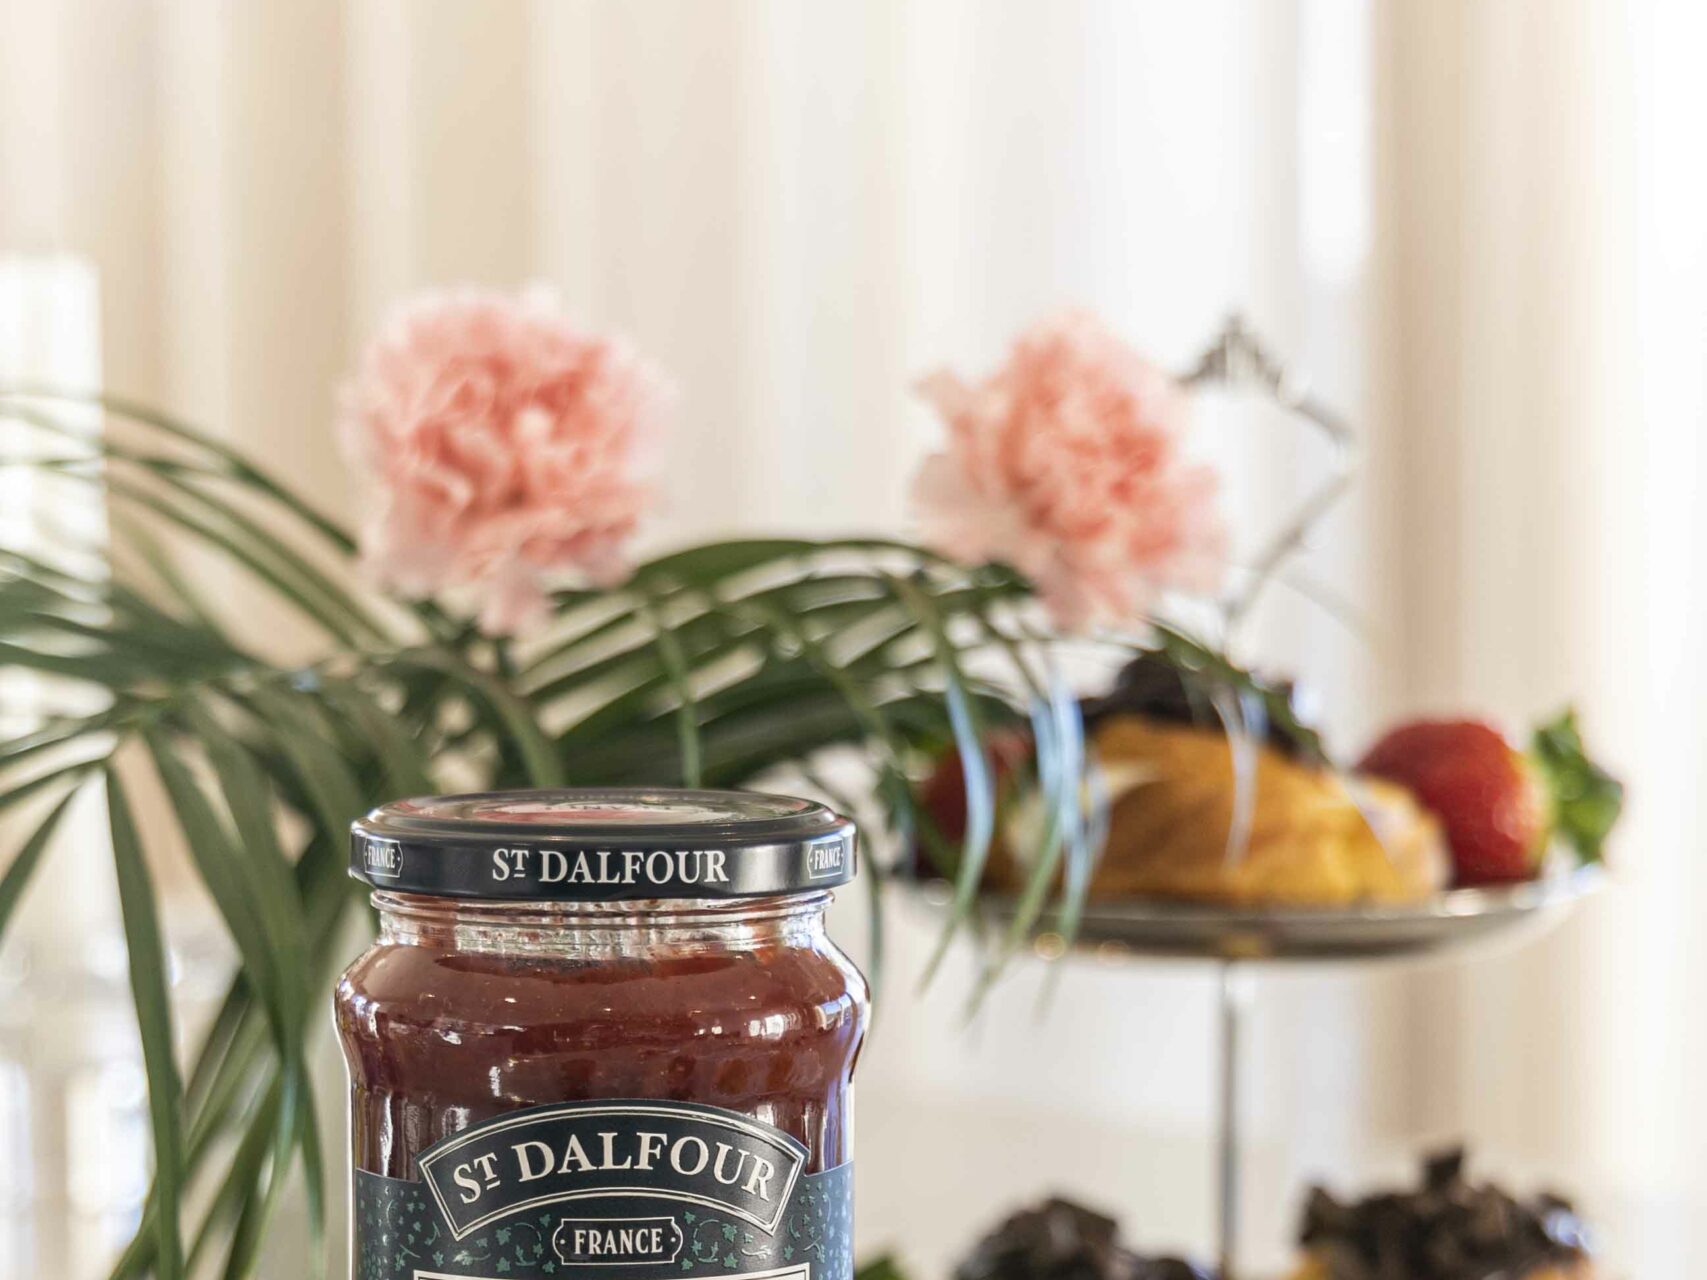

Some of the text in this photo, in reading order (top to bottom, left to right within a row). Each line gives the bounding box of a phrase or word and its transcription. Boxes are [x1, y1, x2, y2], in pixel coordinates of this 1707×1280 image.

[368, 845, 395, 869] FRANCE
[539, 850, 729, 884] DALFOUR
[814, 846, 841, 870] FRANCE
[511, 1132, 775, 1202] DALFOUR
[574, 1228, 663, 1255] FRANCE
